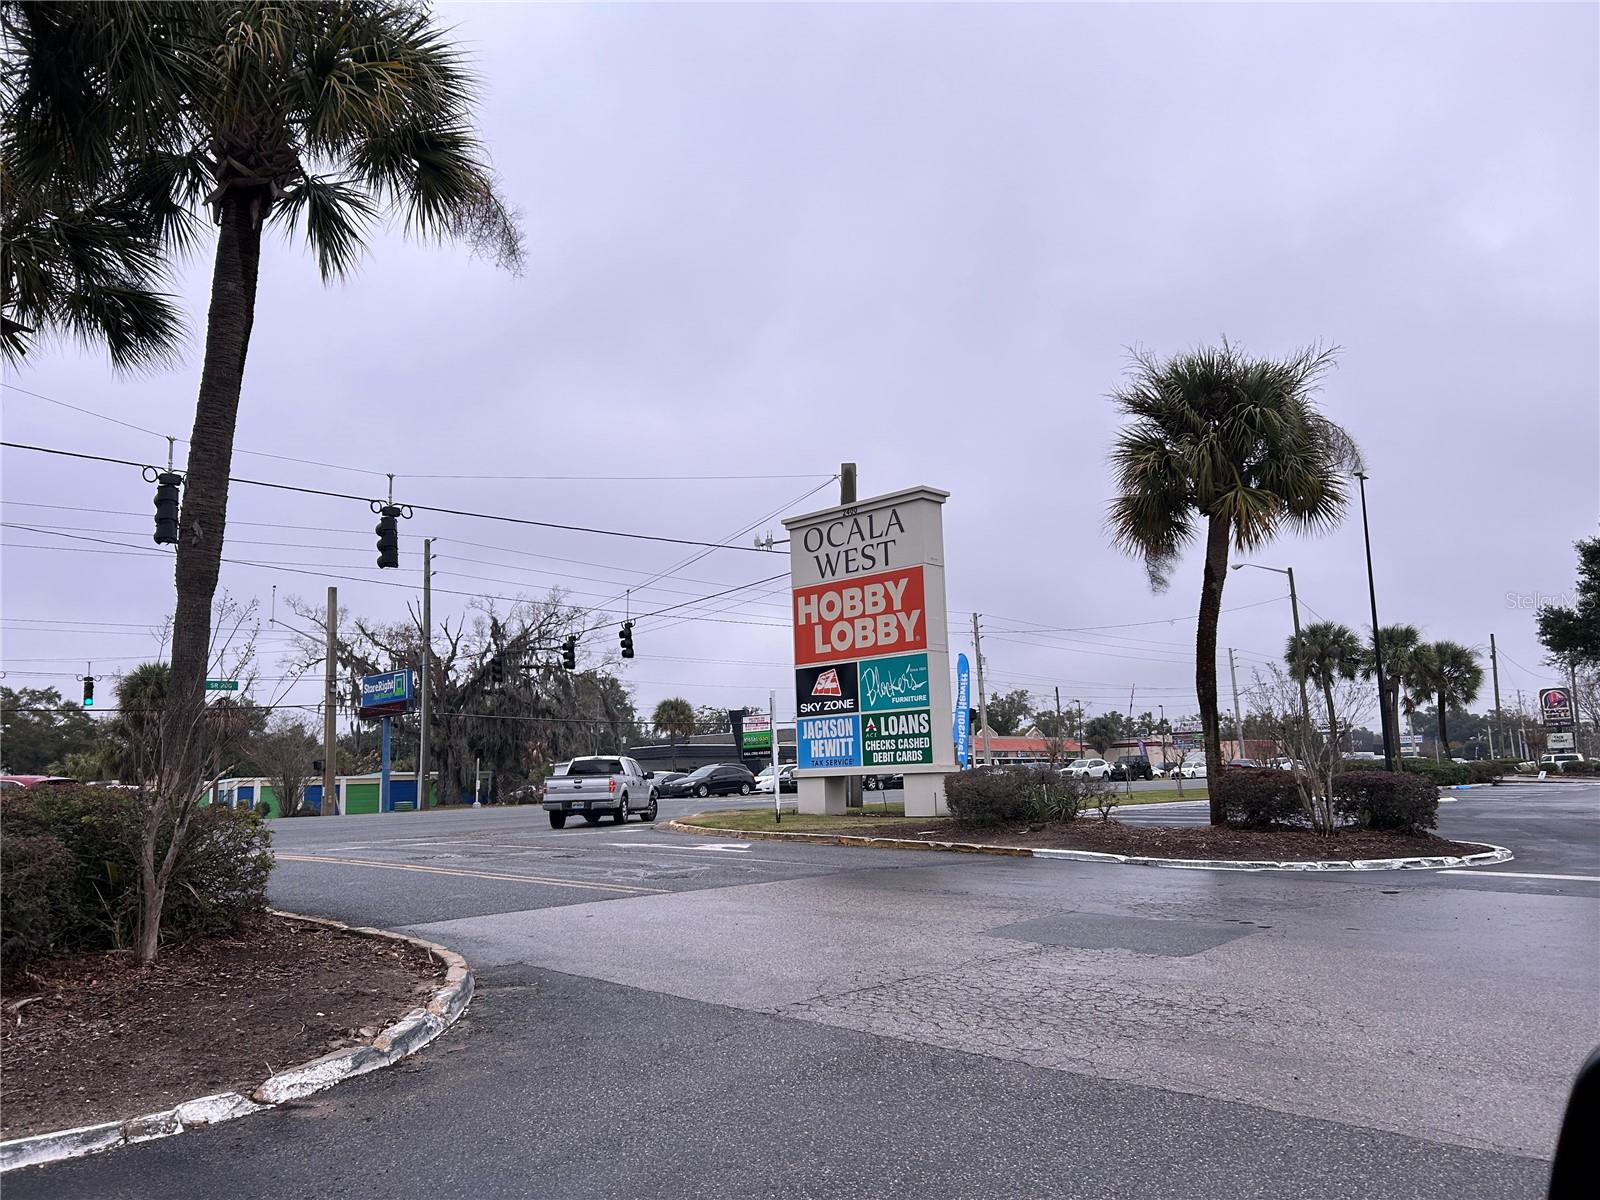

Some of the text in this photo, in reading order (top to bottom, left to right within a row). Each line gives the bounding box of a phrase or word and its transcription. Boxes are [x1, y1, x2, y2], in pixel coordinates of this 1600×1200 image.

[842, 508, 858, 518] 2400
[804, 508, 905, 552] OCALA
[814, 540, 896, 579] WEST
[798, 578, 909, 626] HOBBY
[814, 609, 921, 654] LOBBY
[364, 680, 394, 694] StoreRight
[800, 698, 854, 712] SKY ZONE
[892, 695, 927, 704] FURNITURE
[802, 718, 853, 740] JACKSON
[880, 713, 929, 736] LOANS
[810, 738, 854, 758] HEWITT
[865, 737, 930, 751] CHECKS CASHED
[826, 758, 852, 766] SERVICE
[873, 750, 923, 763] DEBIT CARDS
